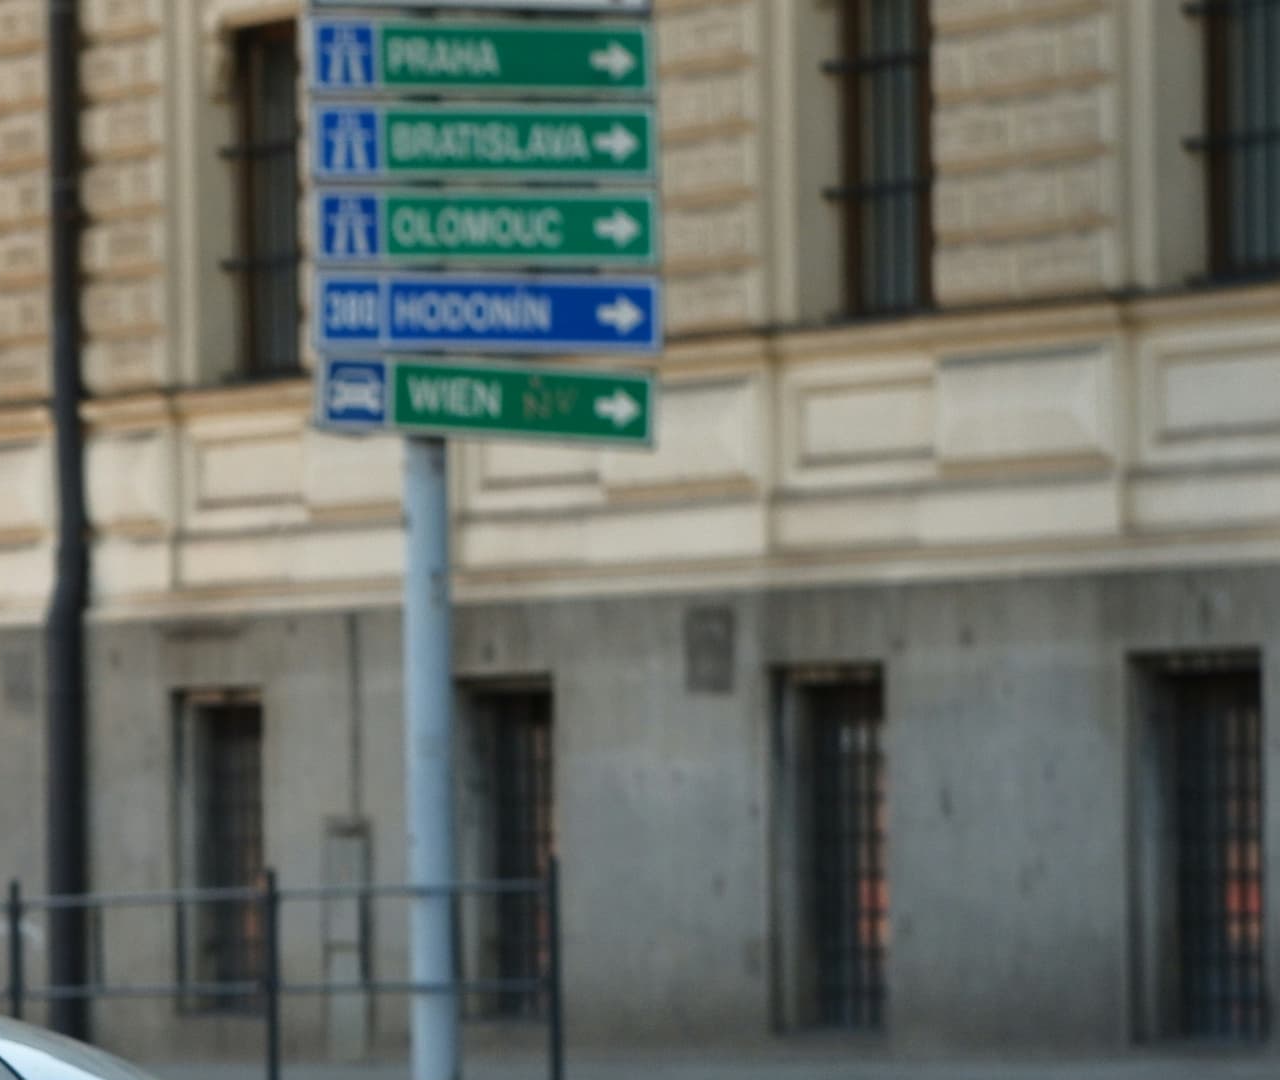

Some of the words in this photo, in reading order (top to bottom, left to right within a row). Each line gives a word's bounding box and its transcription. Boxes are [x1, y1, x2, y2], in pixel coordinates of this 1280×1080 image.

[387, 37, 500, 76] PRAHA
[391, 121, 590, 163] BRATISLAVA
[392, 206, 563, 247] OLOMOUC
[327, 291, 376, 331] 380
[394, 283, 552, 333] HODONÍN
[406, 375, 503, 418] WIEN
